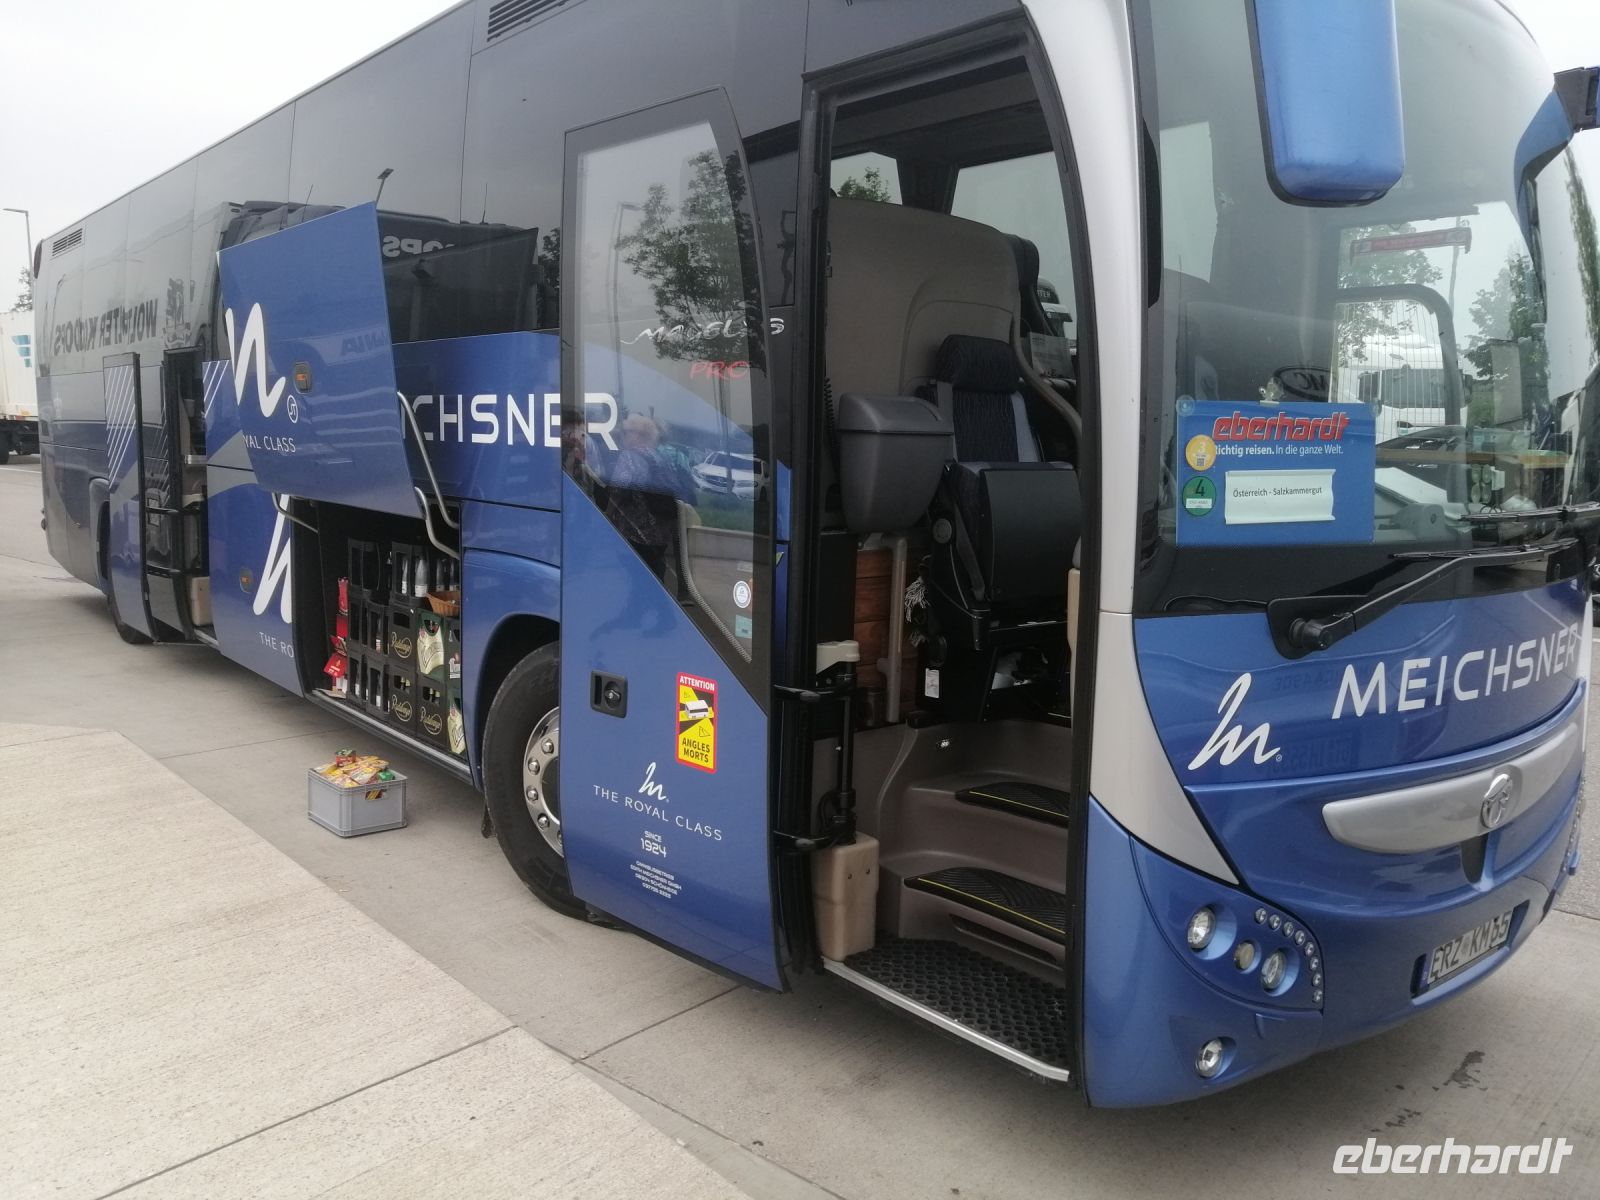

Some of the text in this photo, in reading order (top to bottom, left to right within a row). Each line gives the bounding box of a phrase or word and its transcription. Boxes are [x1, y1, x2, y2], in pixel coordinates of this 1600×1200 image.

[1212, 410, 1350, 441] eberhardt
[263, 435, 296, 453] CLASS
[1245, 446, 1275, 455] reisen.
[1276, 445, 1283, 454] In
[1284, 444, 1298, 455] die
[1299, 446, 1323, 457] ganze
[1324, 444, 1344, 455] Welt.
[1195, 478, 1206, 497] 4
[1232, 488, 1268, 498] Österreich
[1273, 486, 1323, 496] Salzkammergut
[259, 631, 294, 658] THE RO
[1331, 622, 1579, 720] MEICHSNER
[679, 675, 716, 692] ATTENTION
[682, 737, 711, 753] ANGLES
[683, 747, 709, 764] MORTS
[593, 784, 723, 841] THE ROYAL CLASS
[640, 838, 667, 858] 1924
[1430, 935, 1464, 979] ERZ
